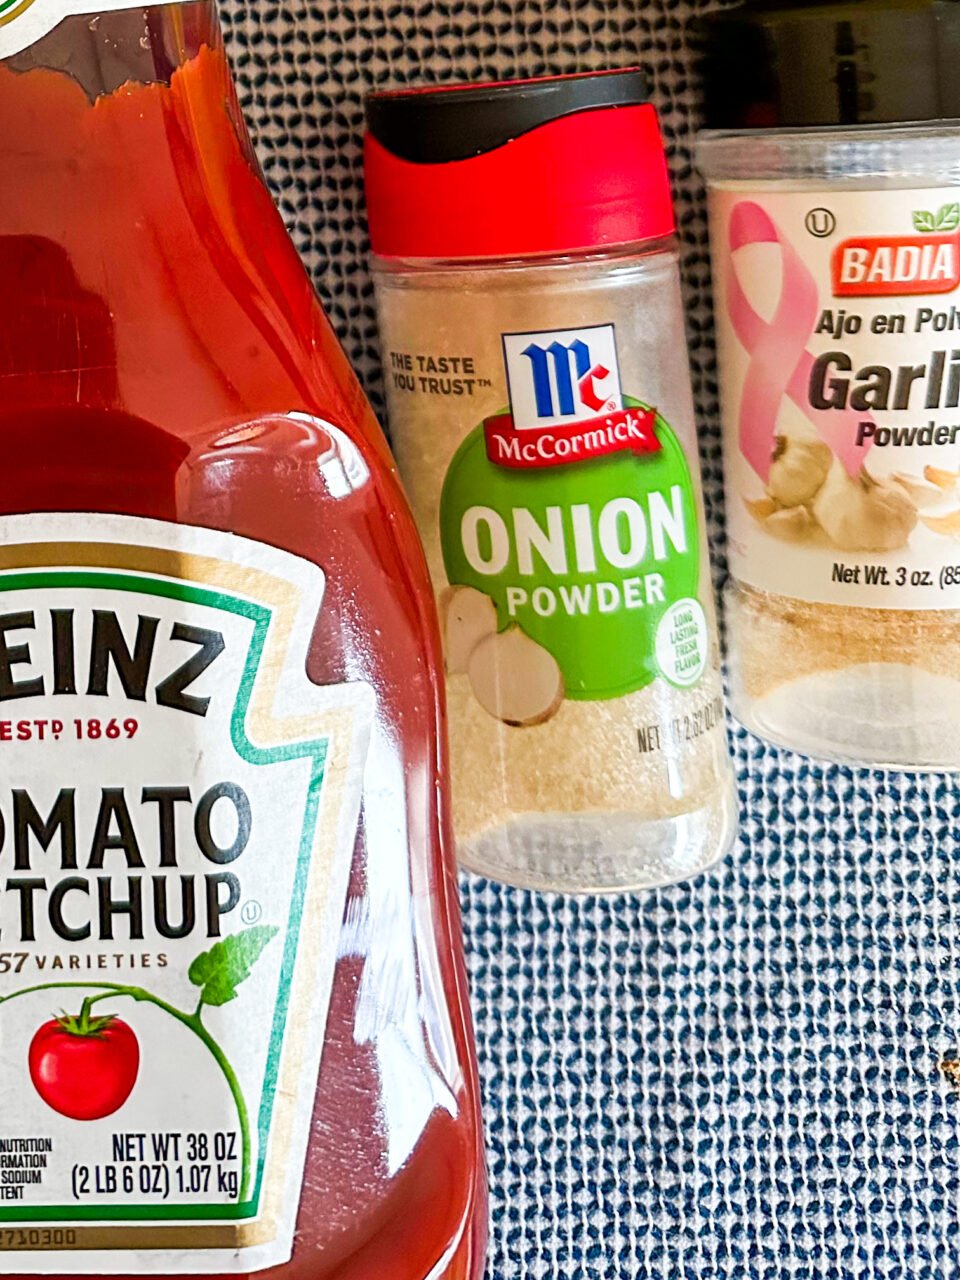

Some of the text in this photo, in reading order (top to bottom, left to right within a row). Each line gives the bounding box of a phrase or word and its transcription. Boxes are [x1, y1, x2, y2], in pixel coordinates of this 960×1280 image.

[841, 242, 956, 285] BADIA
[814, 309, 863, 340] Ajo
[869, 313, 907, 335] en
[390, 352, 475, 374] THE TASTE
[392, 373, 417, 392] YOU
[493, 414, 642, 463] McCormick
[854, 420, 960, 447] Powder
[460, 484, 688, 577] ONION
[831, 564, 860, 585] Net
[864, 566, 891, 587] Wt.
[896, 567, 907, 587] 3
[911, 570, 934, 587] oz.
[507, 572, 667, 617] POWDER
[73, 717, 139, 740] 1869
[637, 725, 661, 753] NET
[35, 953, 168, 971] VARIETIES
[0, 1138, 53, 1153] NUTRITION
[112, 1131, 239, 1162] NET WT 38 OZ
[1, 1170, 42, 1184] SODIUM
[71, 1164, 239, 1199] (2 LB 6 OZ) 1.07 kg
